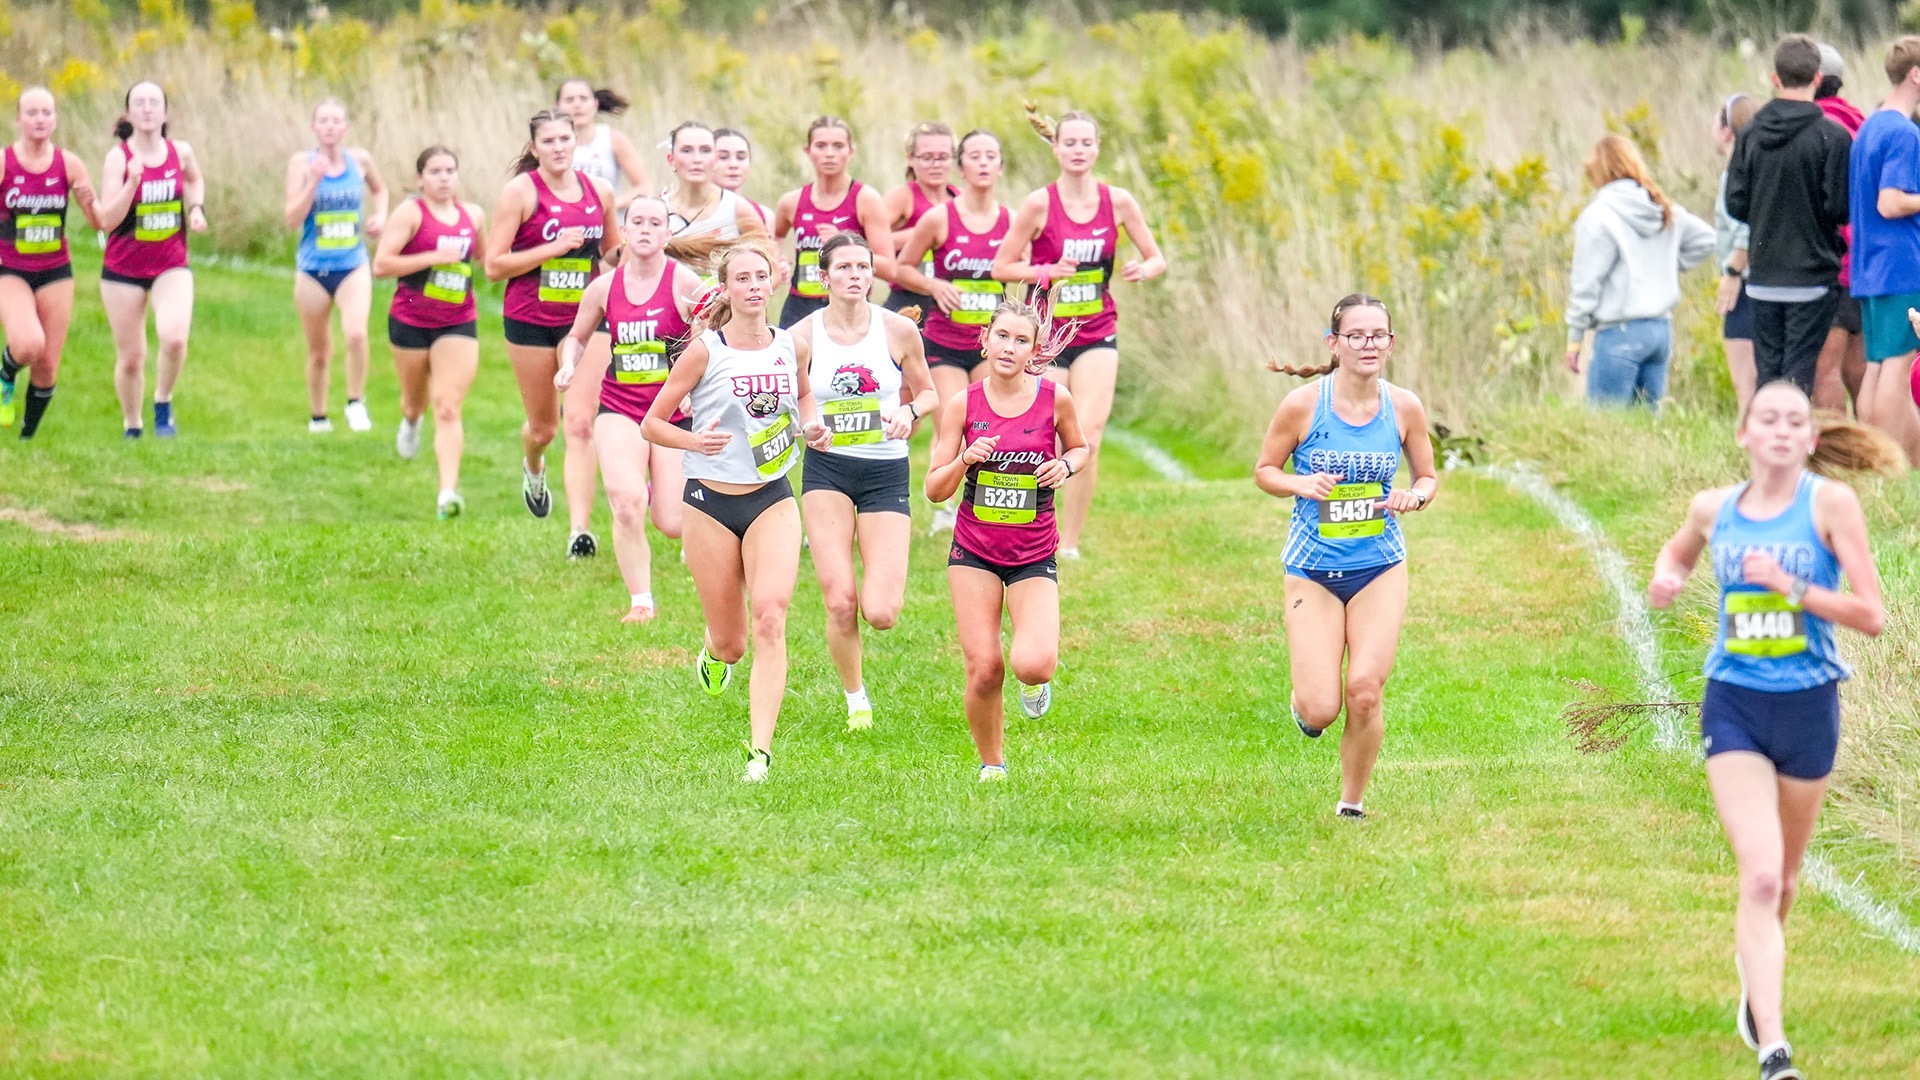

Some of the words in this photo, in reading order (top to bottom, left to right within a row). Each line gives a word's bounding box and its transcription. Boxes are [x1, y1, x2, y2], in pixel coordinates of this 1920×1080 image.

[5, 186, 66, 215] Cougars
[141, 178, 177, 204] RHIT
[1063, 238, 1105, 262] RHIT
[549, 271, 585, 289] 5244
[617, 319, 658, 344] RHIT
[621, 353, 659, 372] 5307
[731, 373, 791, 397] SIUE
[833, 412, 871, 433] 5277
[762, 429, 790, 461] 5371
[984, 487, 1027, 509] 5237
[1329, 498, 1375, 522] 5437
[1734, 611, 1795, 640] 5440
